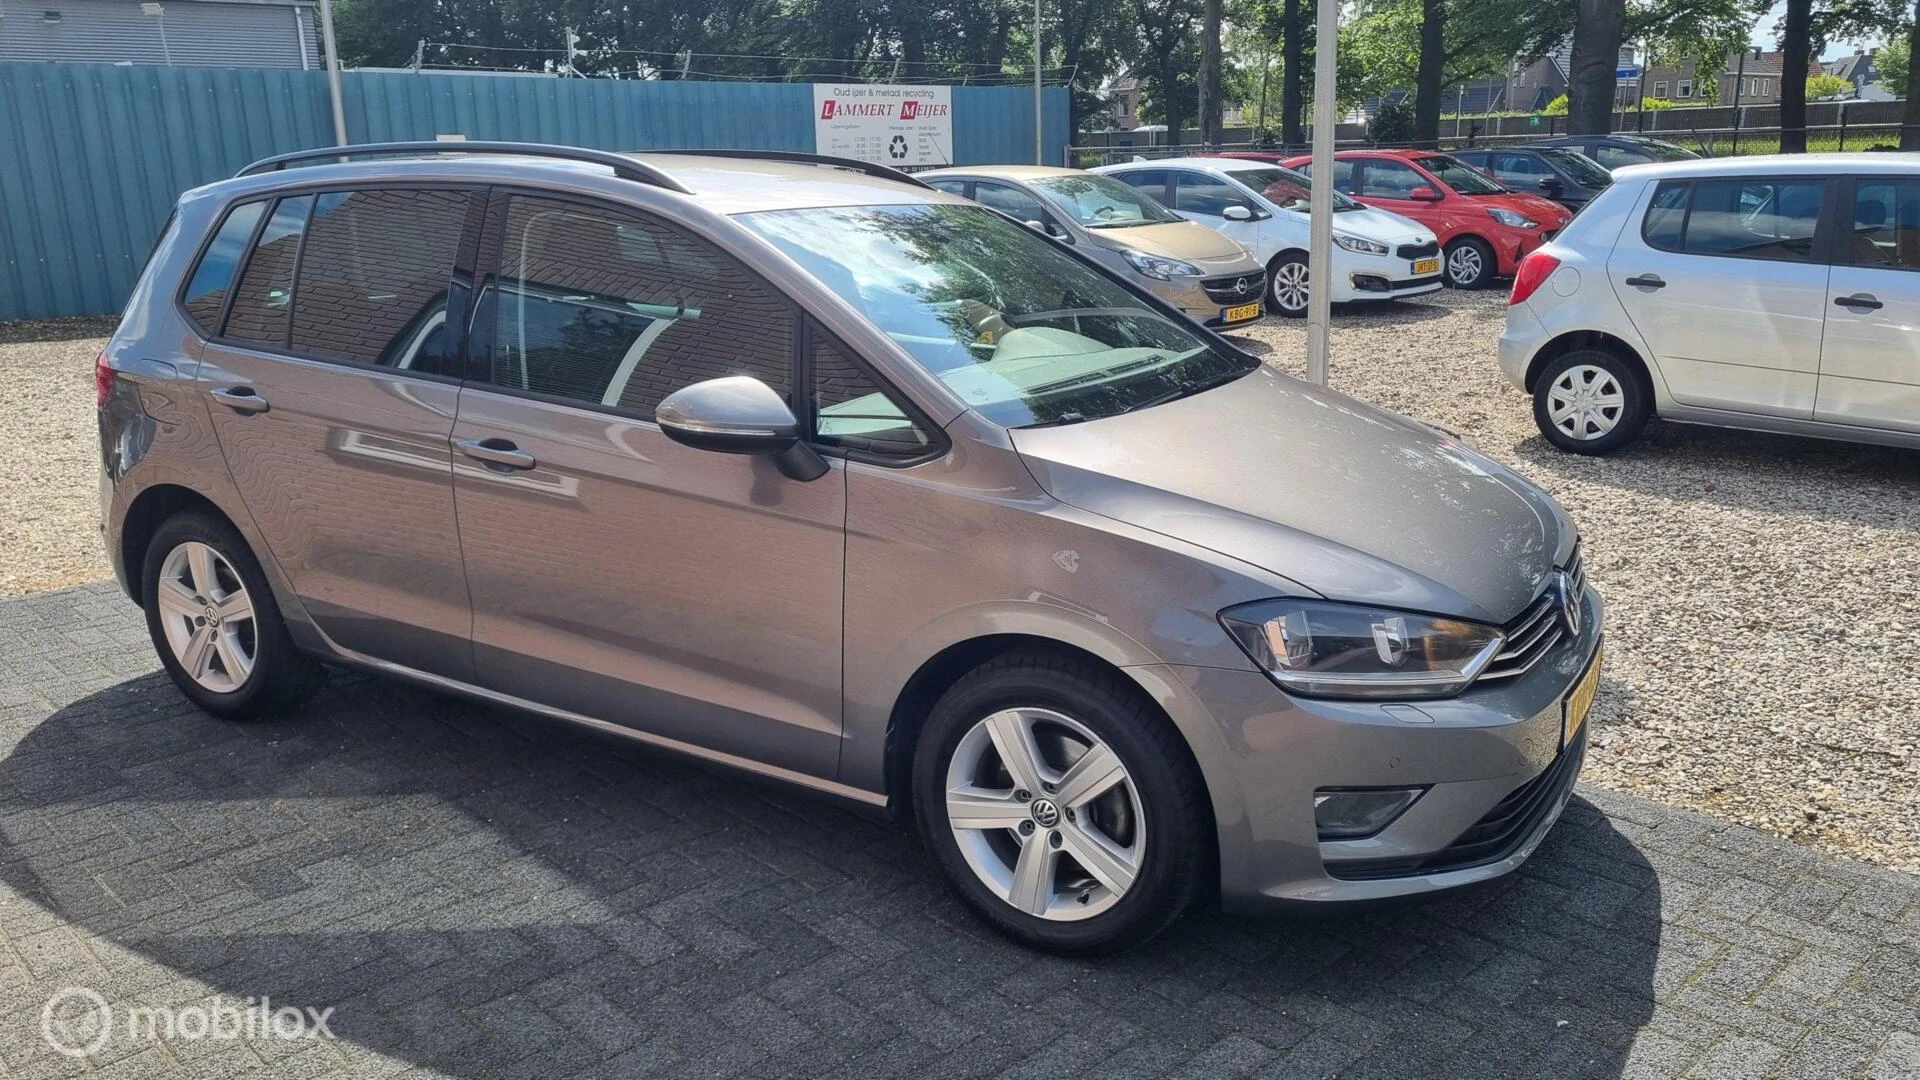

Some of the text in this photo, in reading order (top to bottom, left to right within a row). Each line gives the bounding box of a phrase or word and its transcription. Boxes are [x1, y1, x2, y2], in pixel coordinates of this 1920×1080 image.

[834, 88, 934, 99] Oud ijzer & metaal recycling
[822, 101, 948, 118] LAMMERT MEIJER
